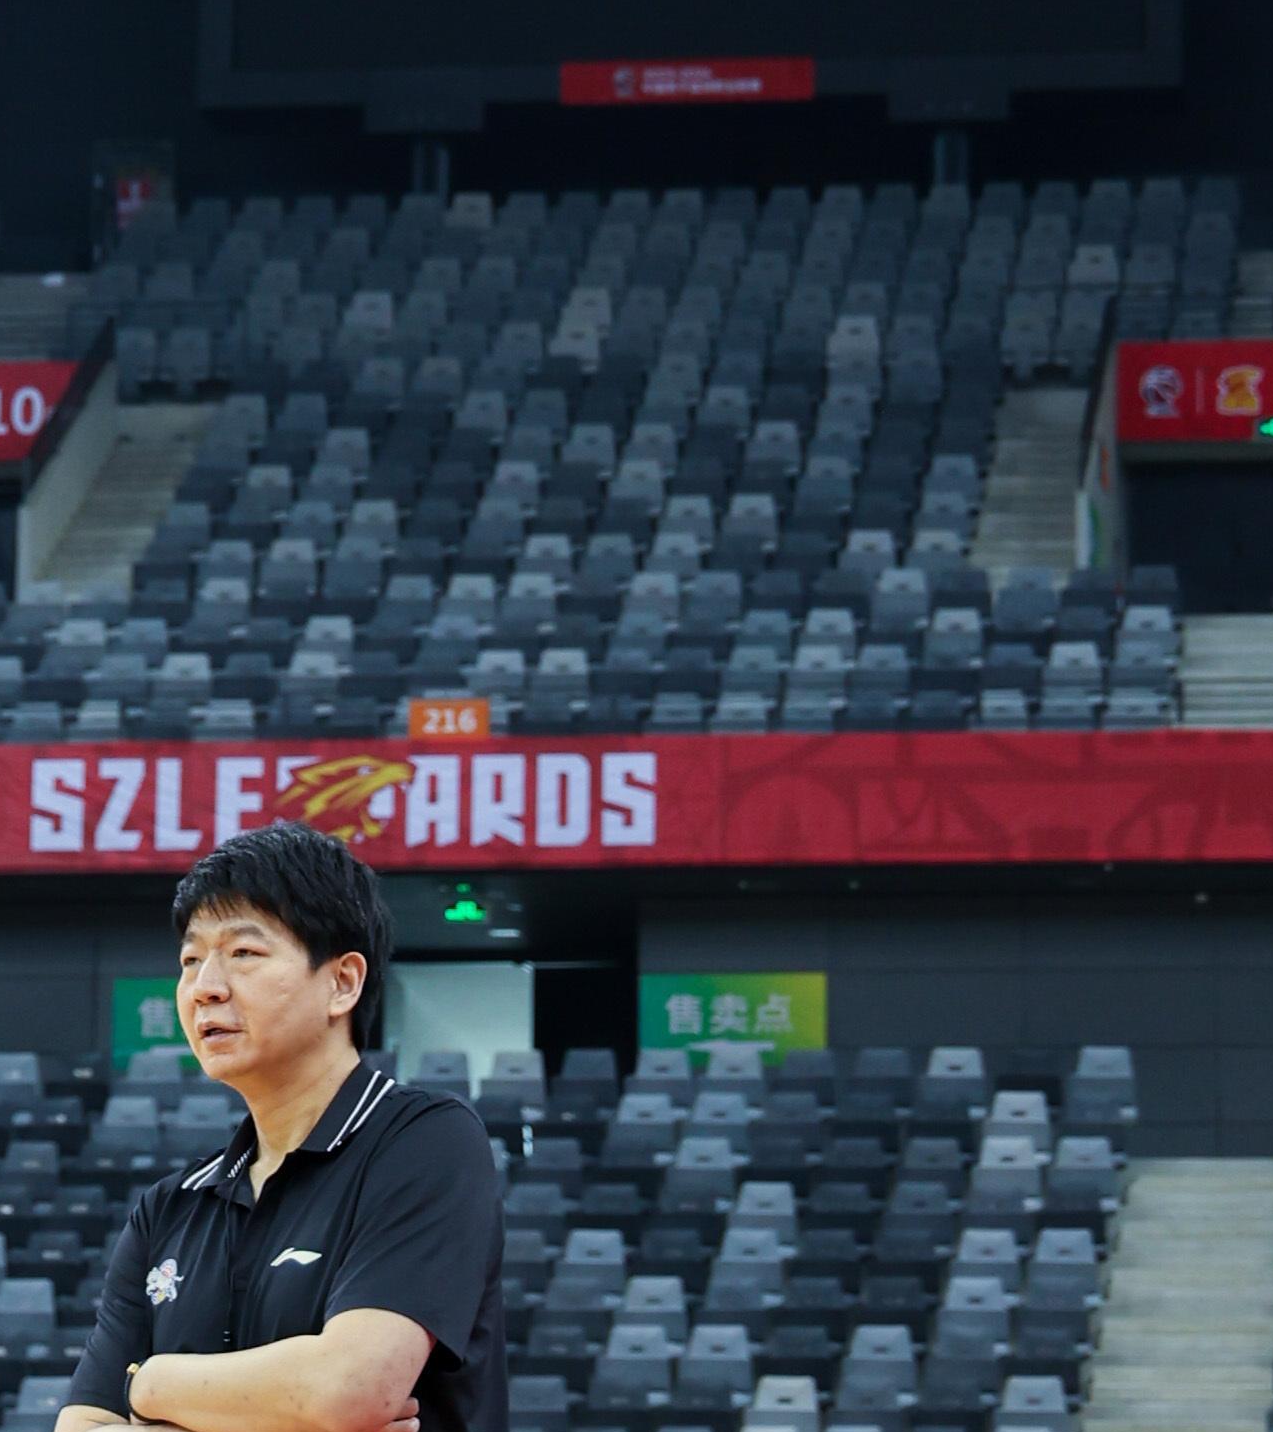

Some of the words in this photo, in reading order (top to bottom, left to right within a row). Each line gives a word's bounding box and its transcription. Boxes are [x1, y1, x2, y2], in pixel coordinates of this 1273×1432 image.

[421, 707, 478, 735] 216
[30, 752, 657, 853] SZLEARDS
[664, 993, 794, 1035] 售卖点
